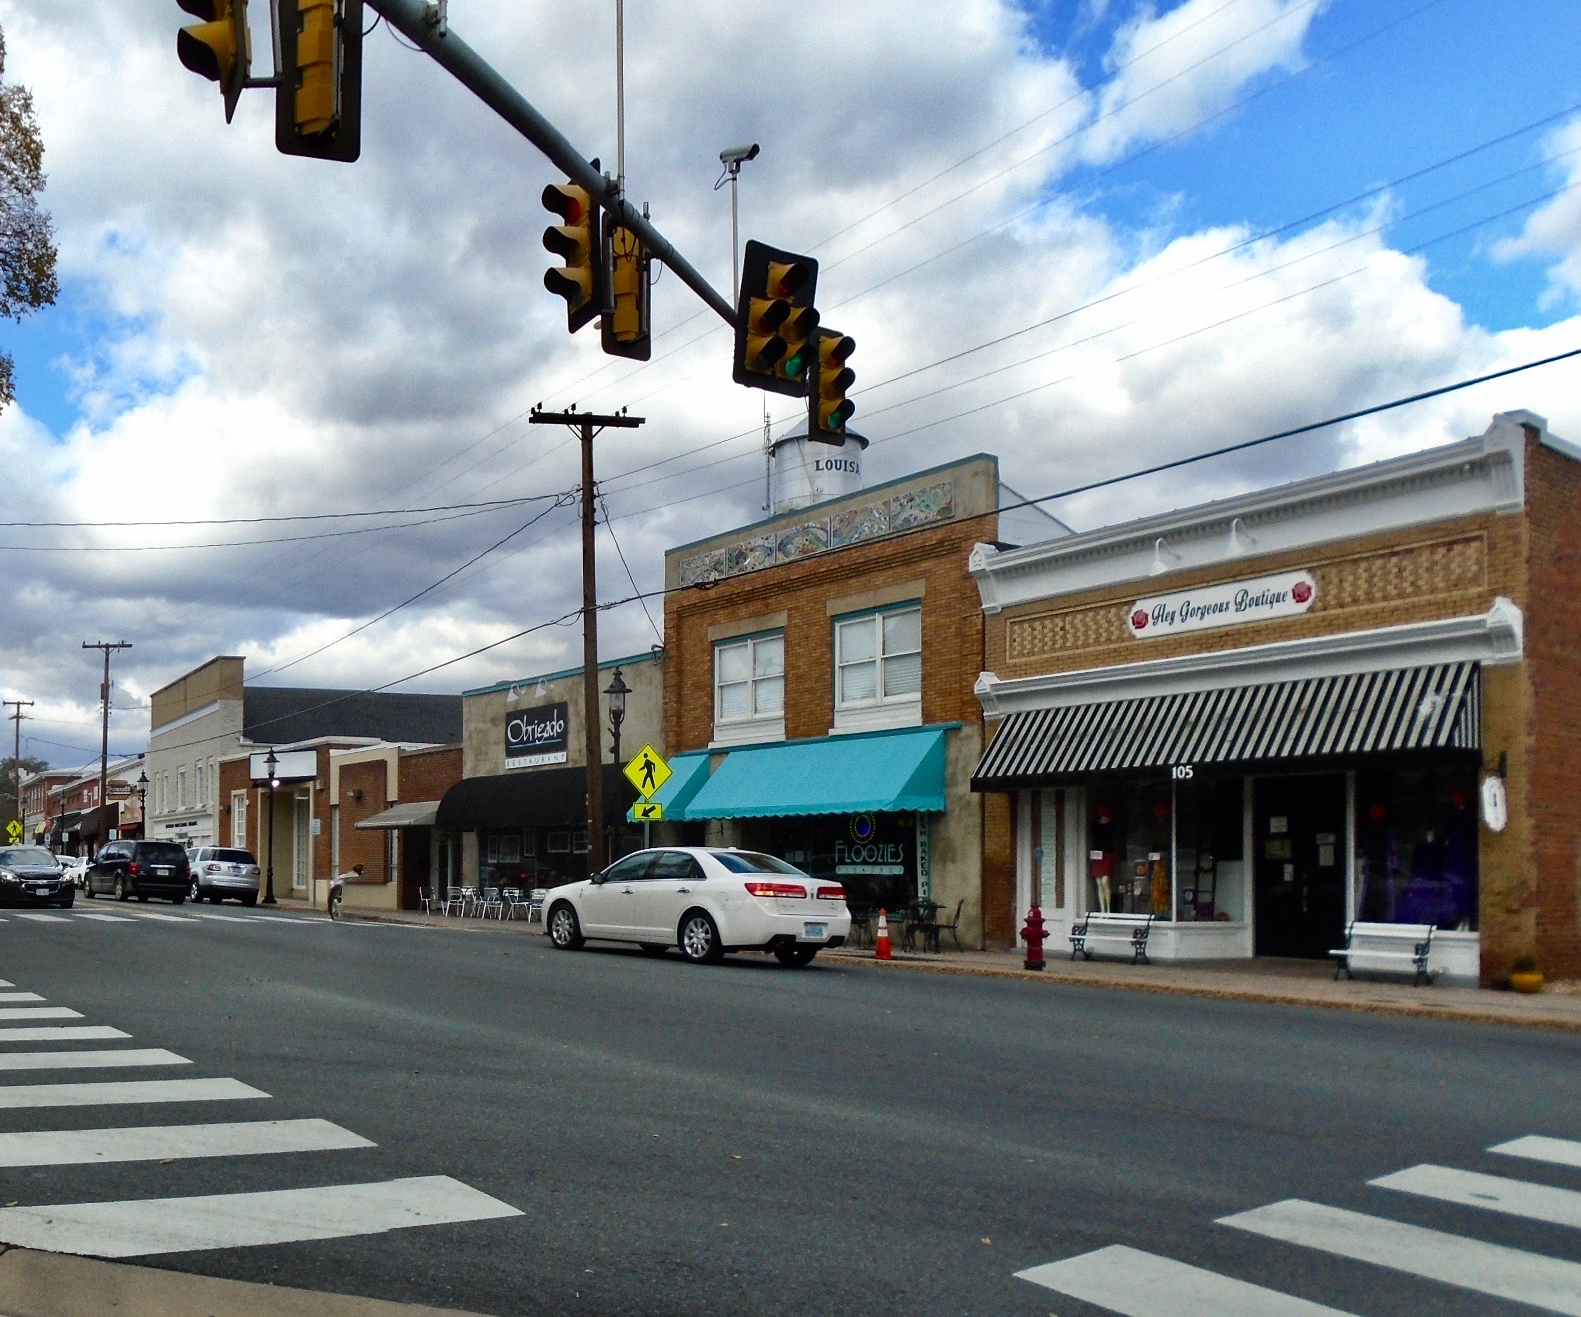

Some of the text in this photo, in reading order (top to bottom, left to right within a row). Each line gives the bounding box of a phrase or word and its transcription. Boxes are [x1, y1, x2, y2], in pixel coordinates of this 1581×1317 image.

[815, 459, 860, 475] LOUISA
[1151, 588, 1288, 626] Hey Gorgeous Boutique
[507, 708, 565, 744] Obrigado
[506, 753, 566, 767] RESTAURANT
[1172, 765, 1194, 778] 105
[835, 840, 904, 863] FLOOZIES
[920, 841, 928, 876] BAKED
